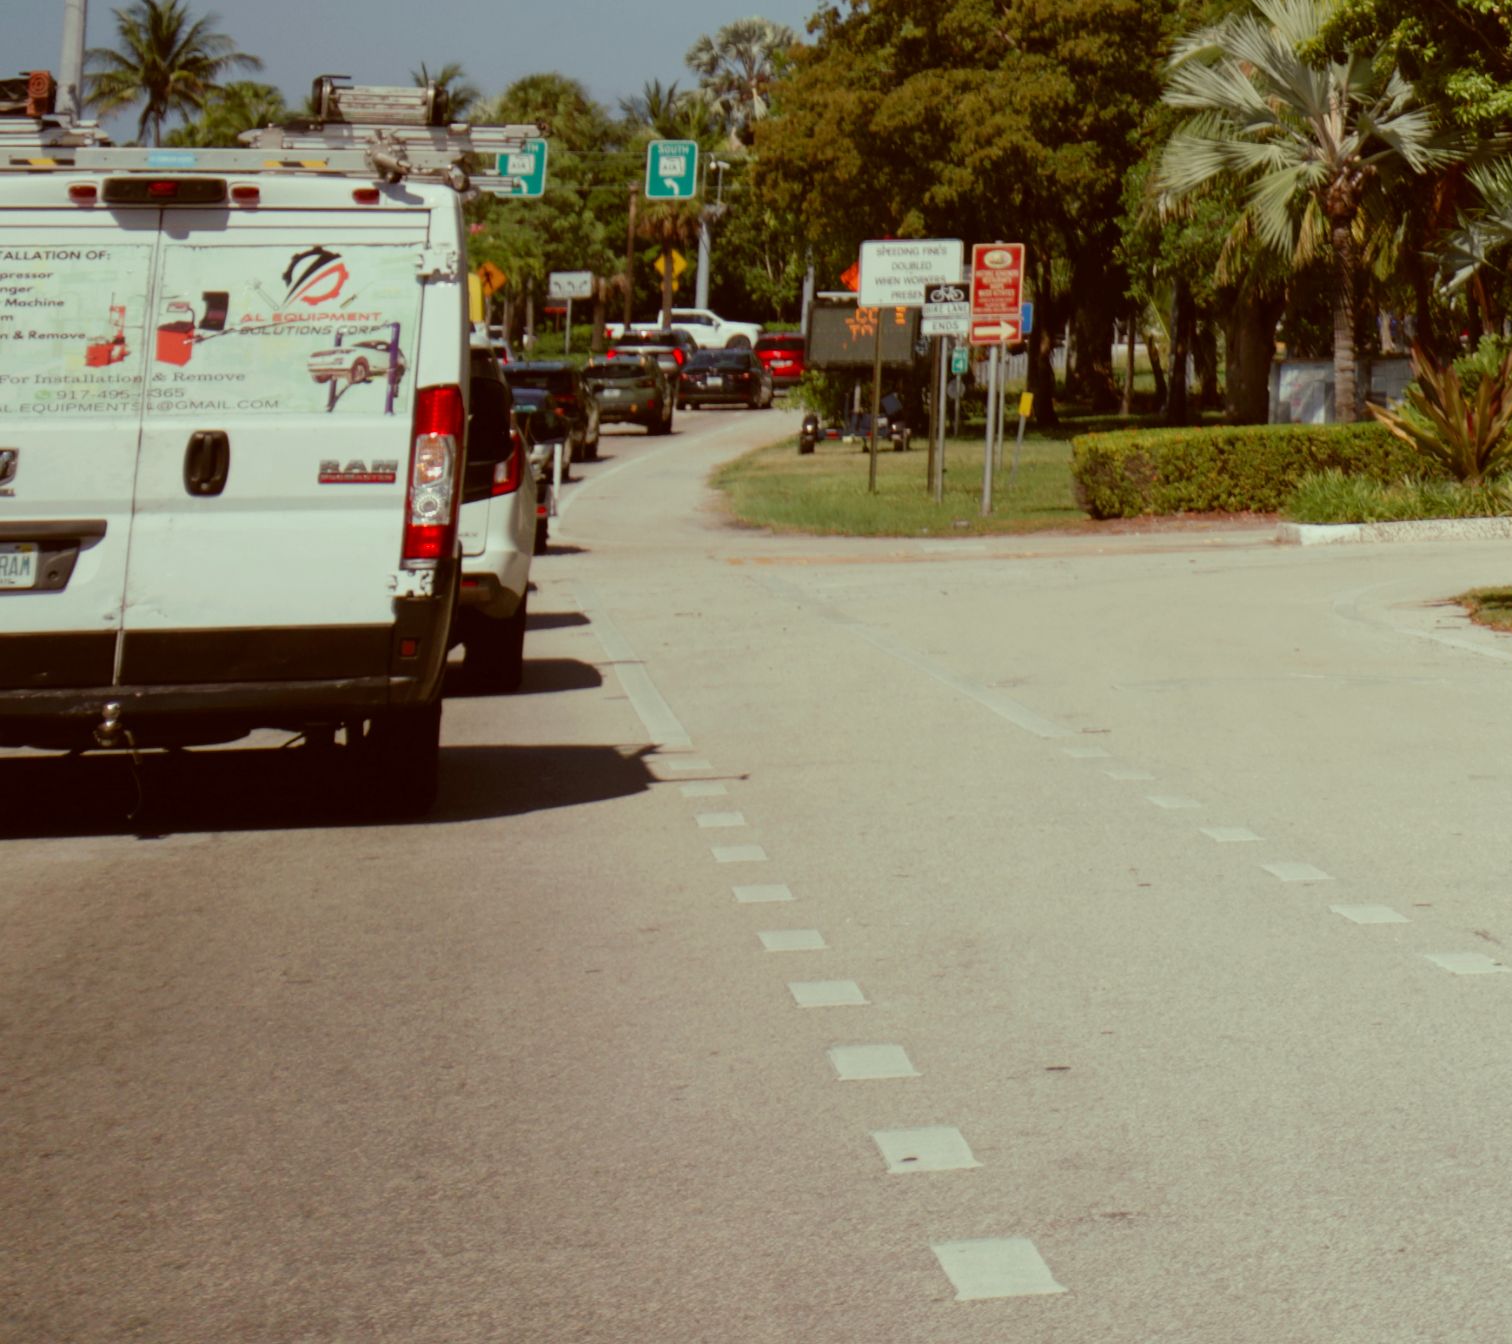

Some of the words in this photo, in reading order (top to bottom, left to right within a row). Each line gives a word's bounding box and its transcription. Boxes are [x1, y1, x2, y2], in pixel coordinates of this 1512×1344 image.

[658, 143, 689, 155] SOUTH
[0, 250, 81, 261] ALLATION
[876, 246, 920, 256] SPEEDING
[891, 262, 932, 271] DOUBLED
[891, 290, 926, 300] PRESEN
[4, 298, 65, 308] Machine
[271, 311, 382, 323] EQUIPMENT
[239, 325, 332, 336] SOLUTIONS
[932, 321, 959, 331] ENDS
[28, 330, 86, 340] Remove
[0, 374, 30, 384] For
[34, 373, 143, 384] Installation
[172, 371, 246, 383] Remove
[319, 459, 399, 473] RAM
